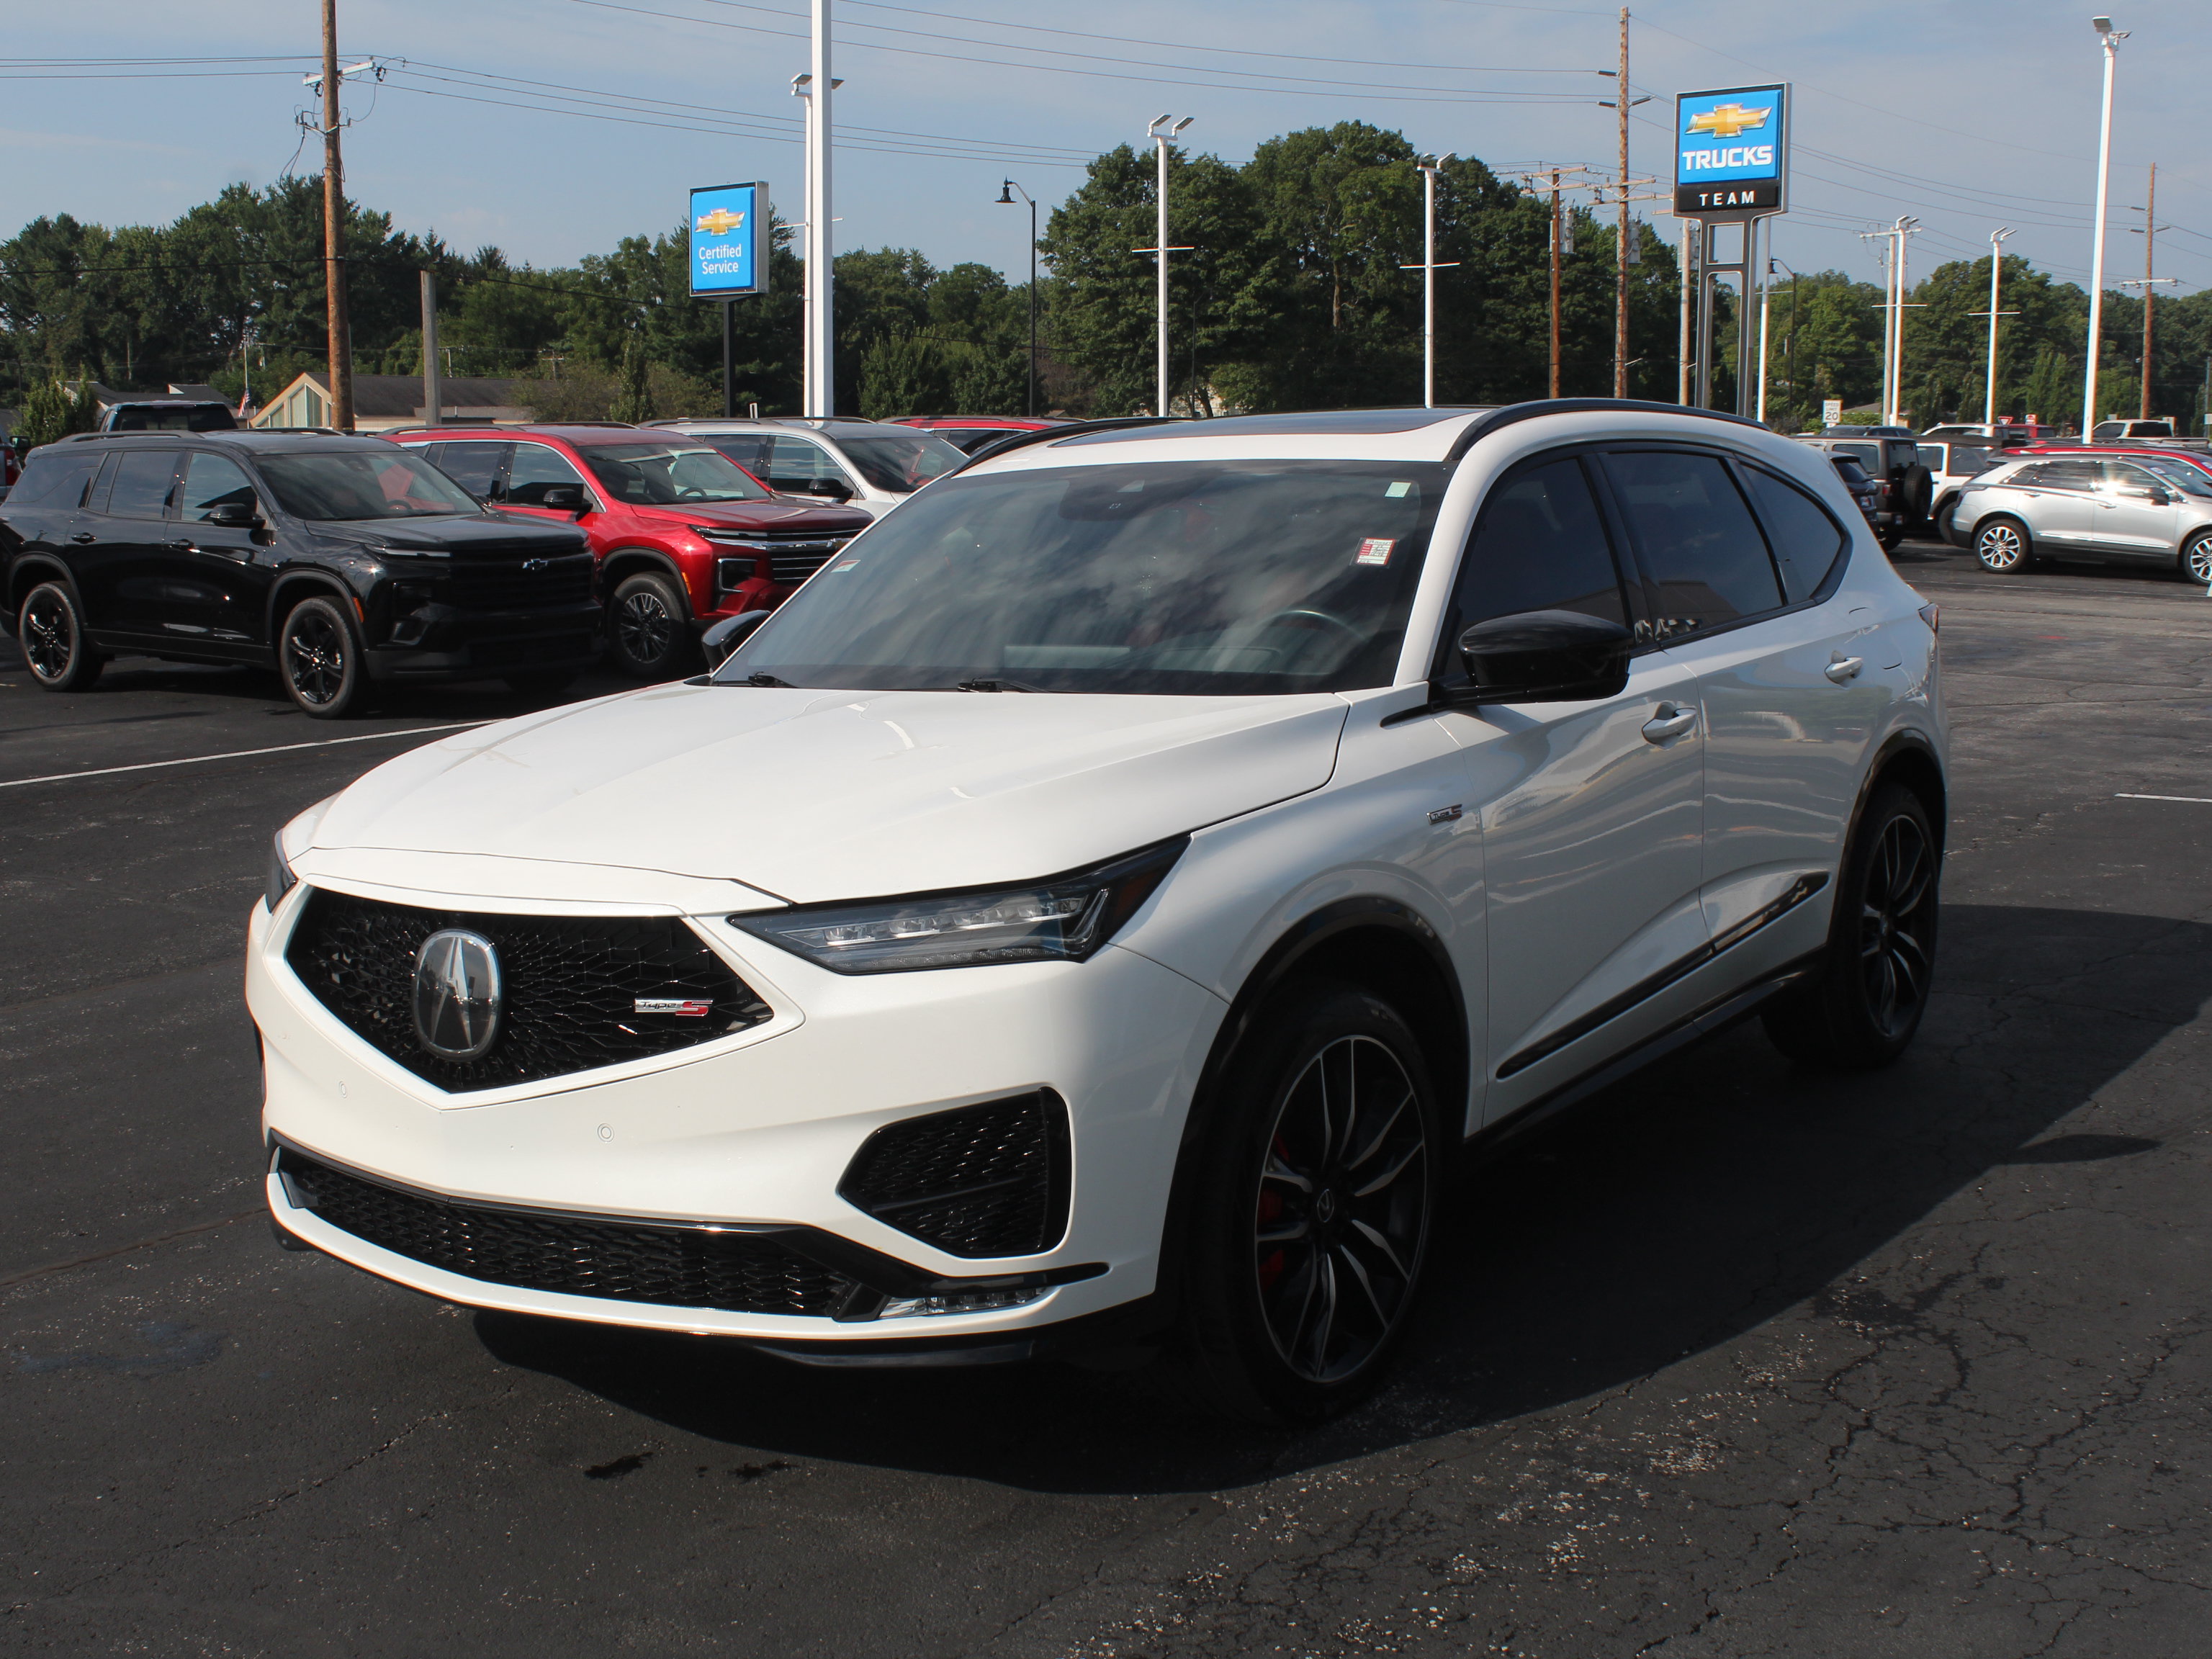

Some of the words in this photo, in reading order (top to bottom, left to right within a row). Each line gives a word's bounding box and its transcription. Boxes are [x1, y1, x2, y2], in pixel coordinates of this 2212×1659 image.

[1682, 145, 1773, 171] TRUCKS
[1699, 190, 1756, 207] TEAM
[698, 243, 742, 260] Certified
[702, 260, 739, 275] Service
[1825, 411, 1839, 421] 20
[1433, 811, 1449, 820] Type
[1448, 804, 1463, 822] S
[642, 1000, 678, 1010] Type
[675, 999, 714, 1017] S
